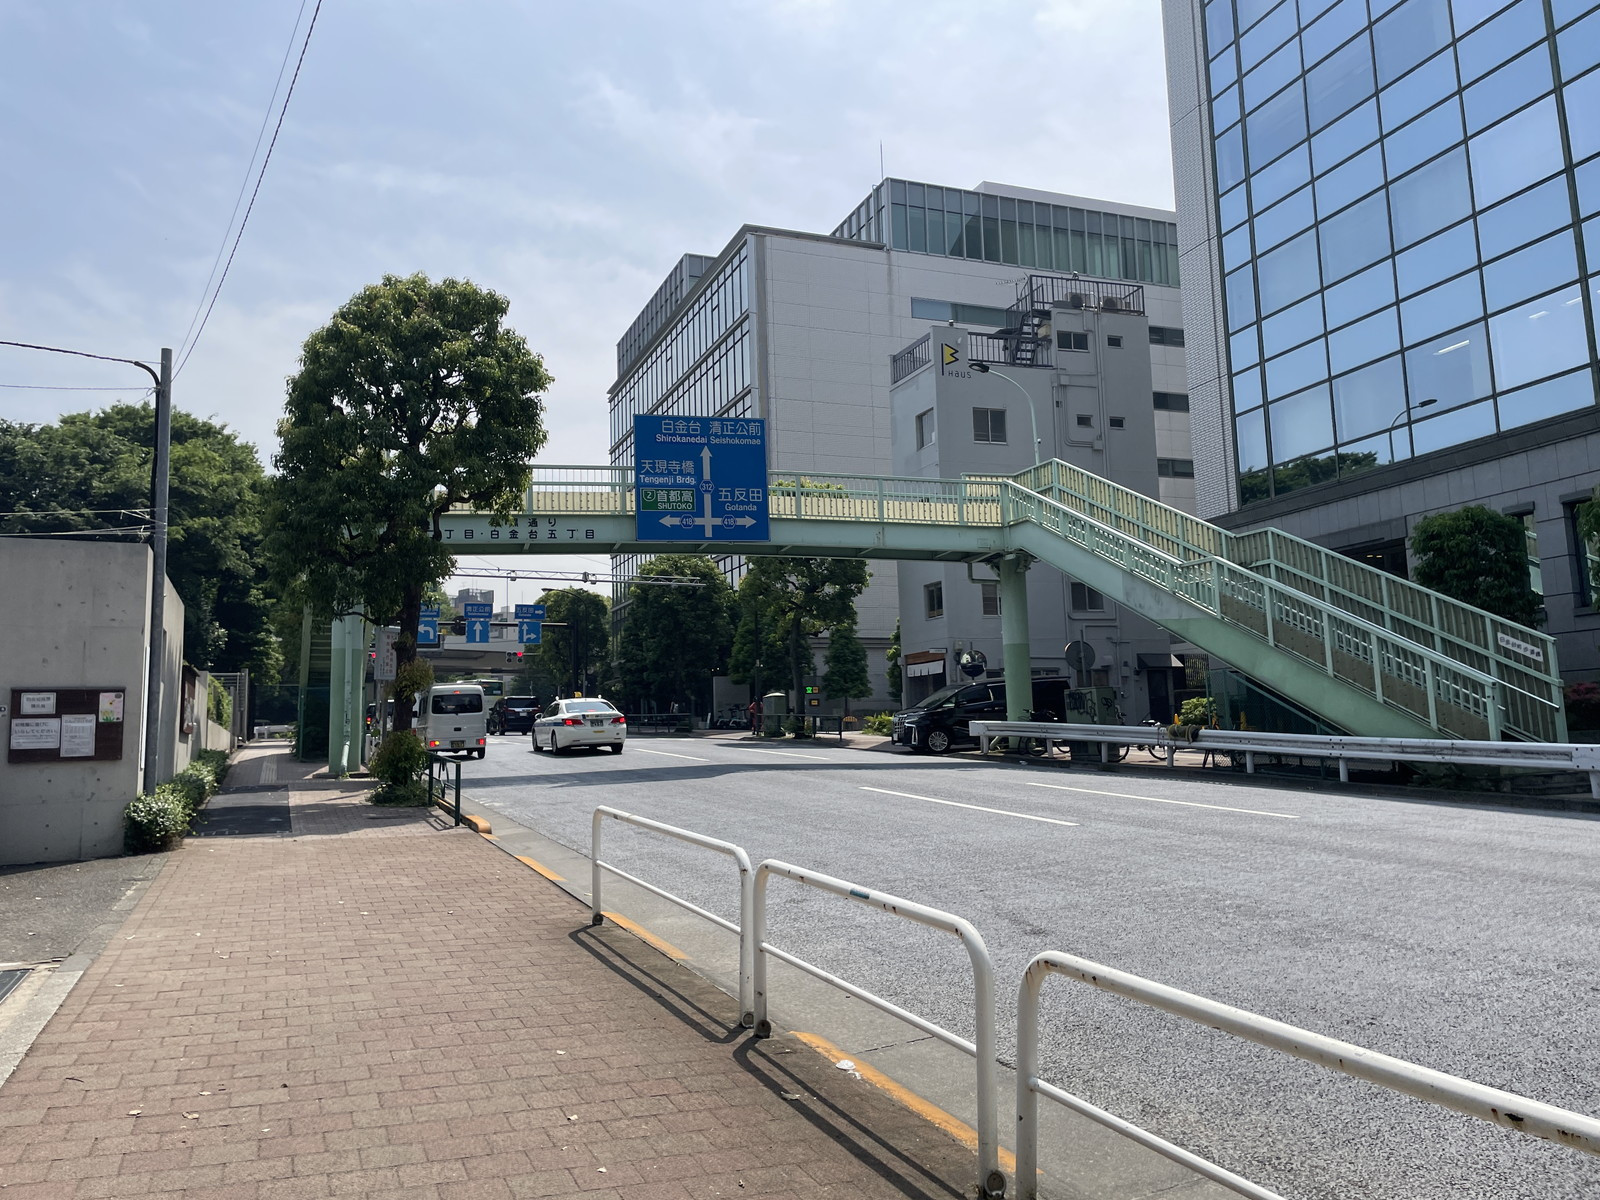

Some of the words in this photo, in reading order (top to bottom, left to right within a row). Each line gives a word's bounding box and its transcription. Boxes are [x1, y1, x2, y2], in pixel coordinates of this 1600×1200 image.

[661, 419, 701, 434] 白金台
[709, 421, 761, 436] 清正公前
[656, 434, 707, 444] Shirokanedai
[710, 436, 761, 445] Seishokomae
[641, 460, 694, 474] 天現寺橋
[639, 474, 674, 485] Tengenji
[676, 475, 697, 485] Brdg.
[701, 483, 713, 491] 312
[646, 491, 653, 499] 2
[656, 490, 693, 502] 首都高
[718, 488, 762, 502] 五反田
[657, 502, 693, 510] SHUTOKO
[682, 517, 693, 526] 418
